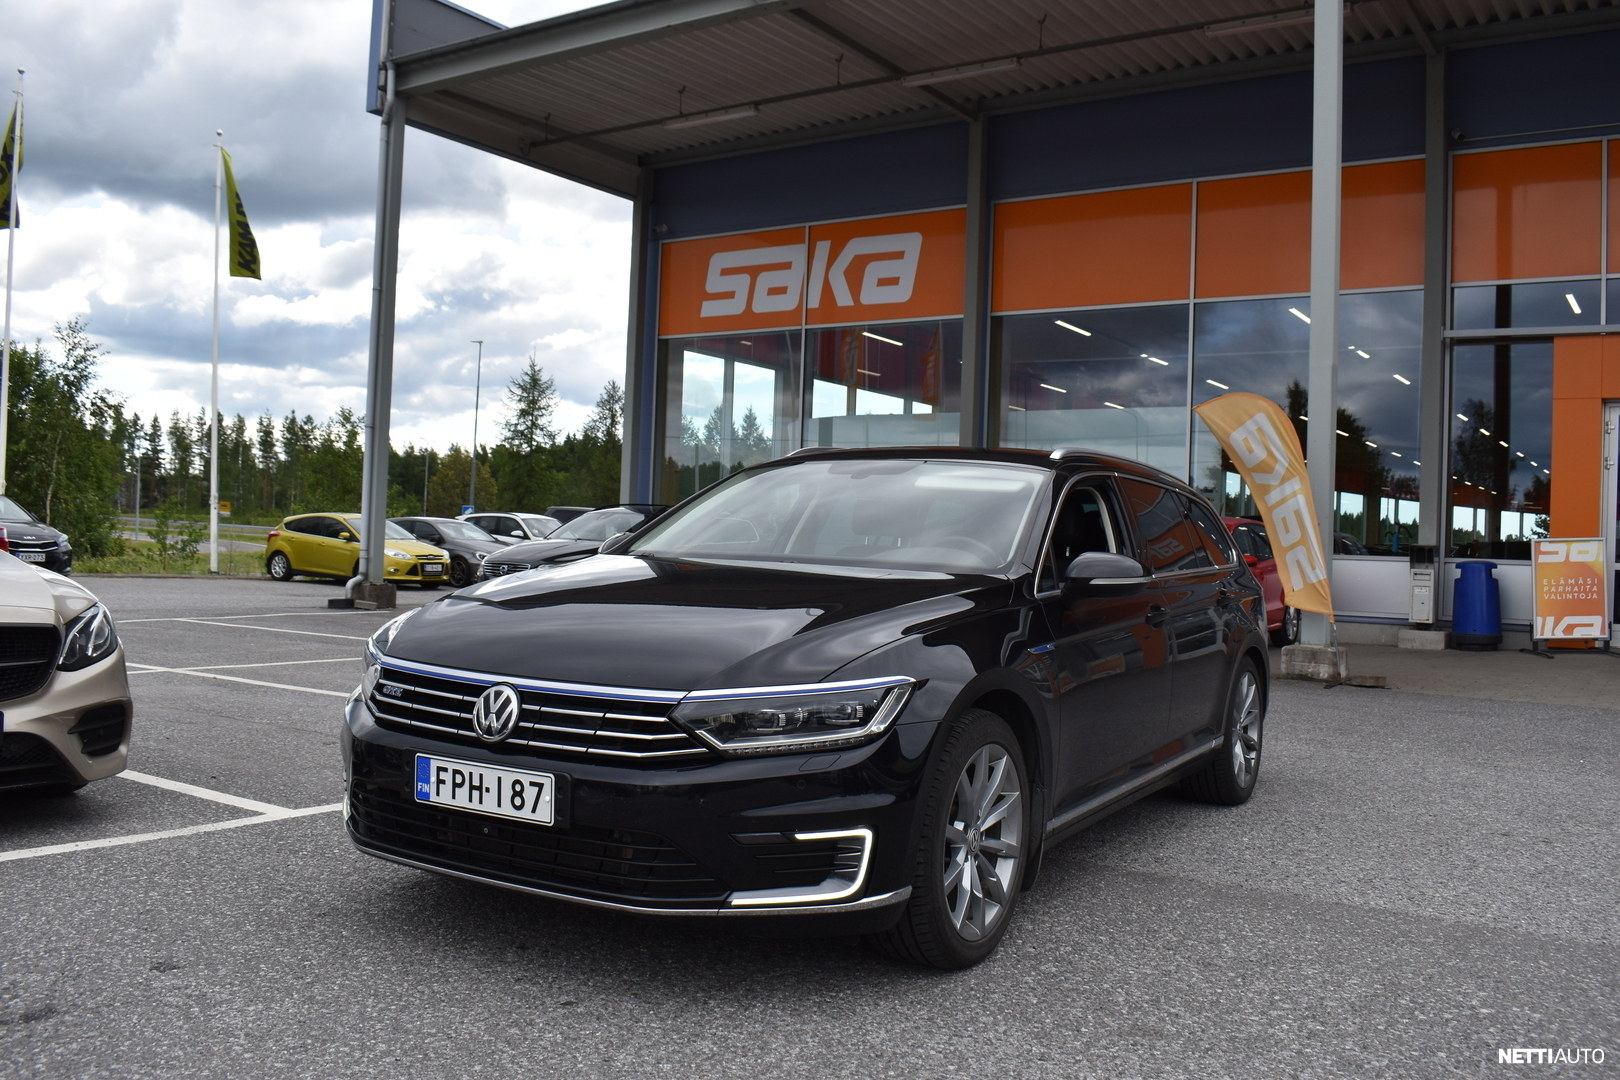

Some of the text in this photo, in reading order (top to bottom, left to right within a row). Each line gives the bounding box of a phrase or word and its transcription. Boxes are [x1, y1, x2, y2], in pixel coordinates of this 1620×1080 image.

[1543, 576, 1598, 585] ELÄMÄSI
[1543, 585, 1598, 593] PARHAITA
[417, 782, 430, 793] FIN
[436, 766, 545, 814] FPH-187
